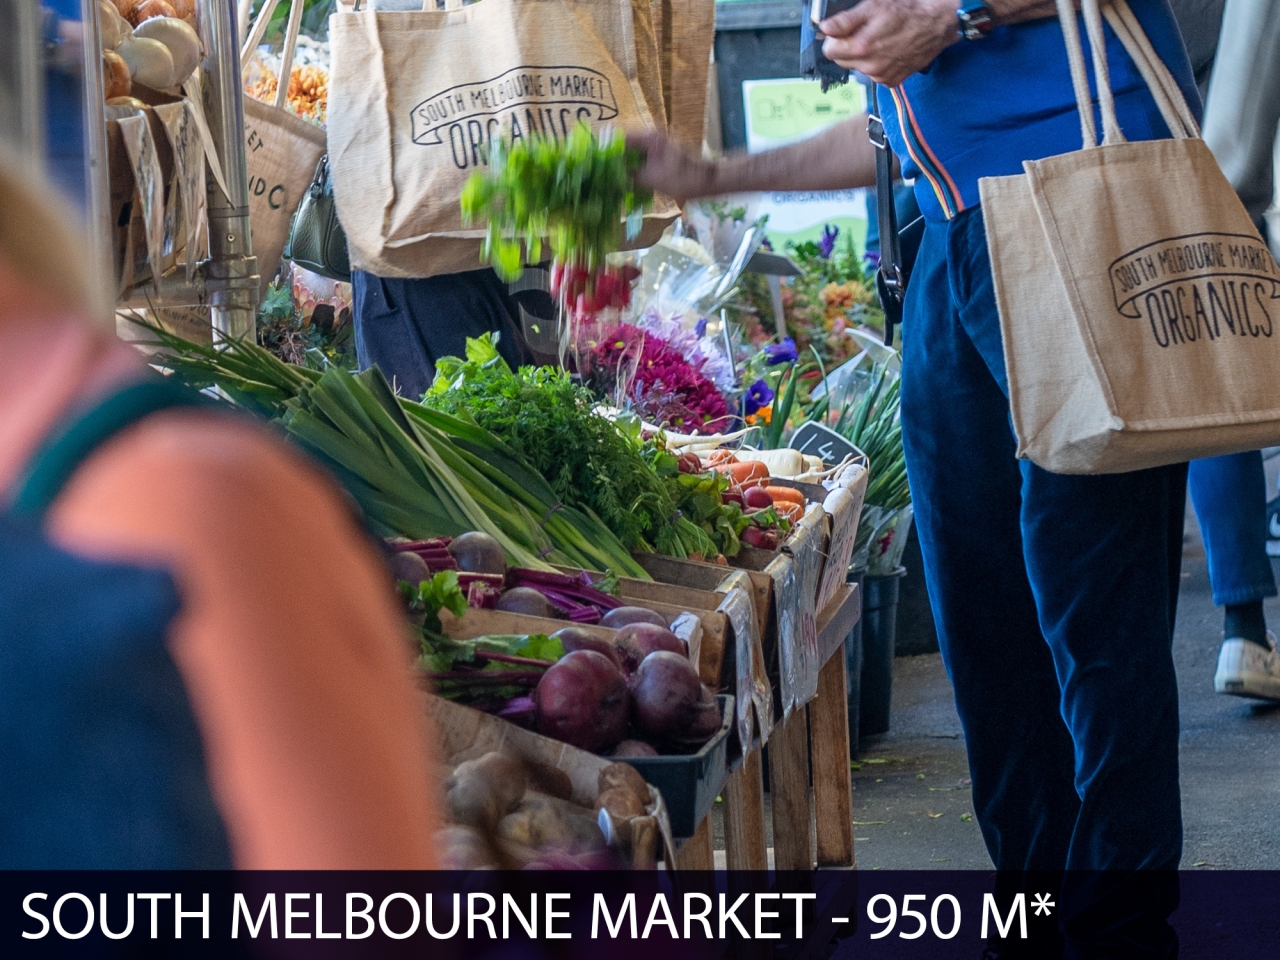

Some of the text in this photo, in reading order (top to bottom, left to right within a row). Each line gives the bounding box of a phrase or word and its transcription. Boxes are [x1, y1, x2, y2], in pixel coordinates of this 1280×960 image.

[419, 74, 604, 126] SOUTH MELBOURNE MARKET
[1115, 242, 1276, 292] SOUTH MELBOURNE MARKET
[1145, 280, 1273, 348] ORGANICS
